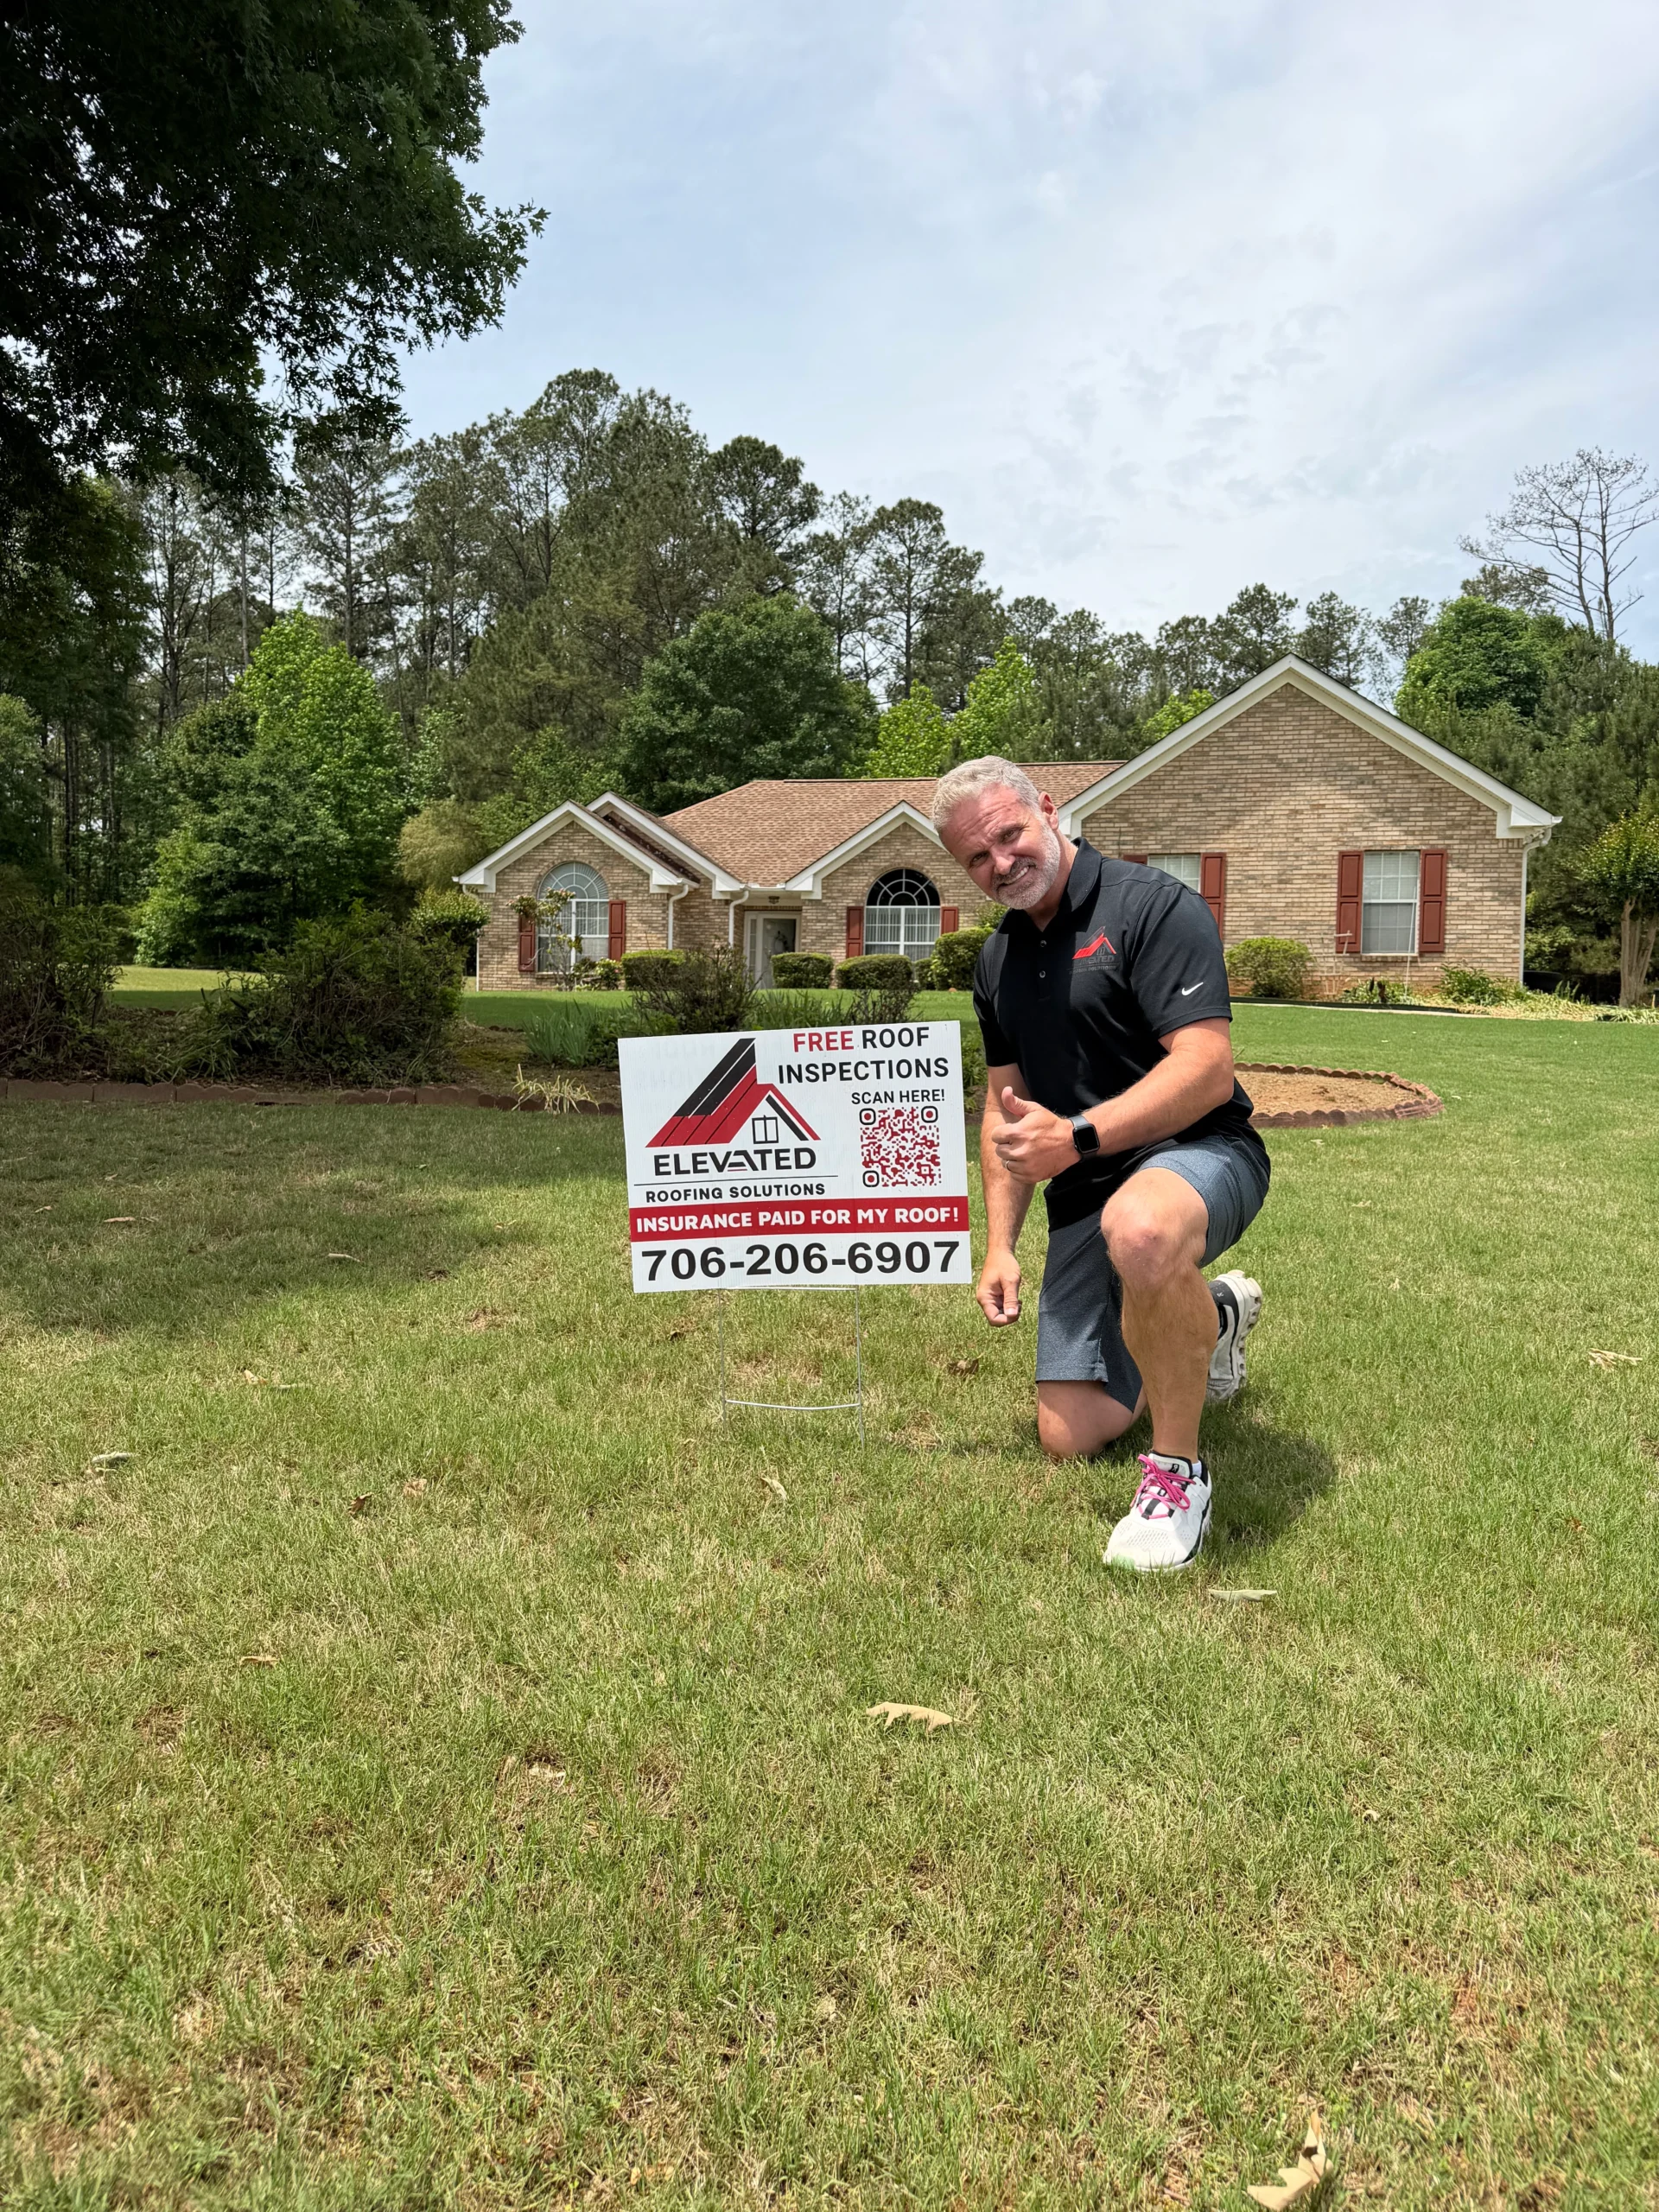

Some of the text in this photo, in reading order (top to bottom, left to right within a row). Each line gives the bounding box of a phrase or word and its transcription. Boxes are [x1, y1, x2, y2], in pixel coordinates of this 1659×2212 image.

[794, 1027, 929, 1052] FREE ROOF
[779, 1058, 948, 1084] INSPECTIONS
[852, 1089, 944, 1104] SCAN HERE!
[654, 1147, 817, 1176] ELEVATED
[646, 1184, 824, 1203] ROOFING SOLUTIONS
[637, 1208, 957, 1232] INSURANCE PAID FOR MY ROOF!
[641, 1241, 959, 1281] 706-206-6907
